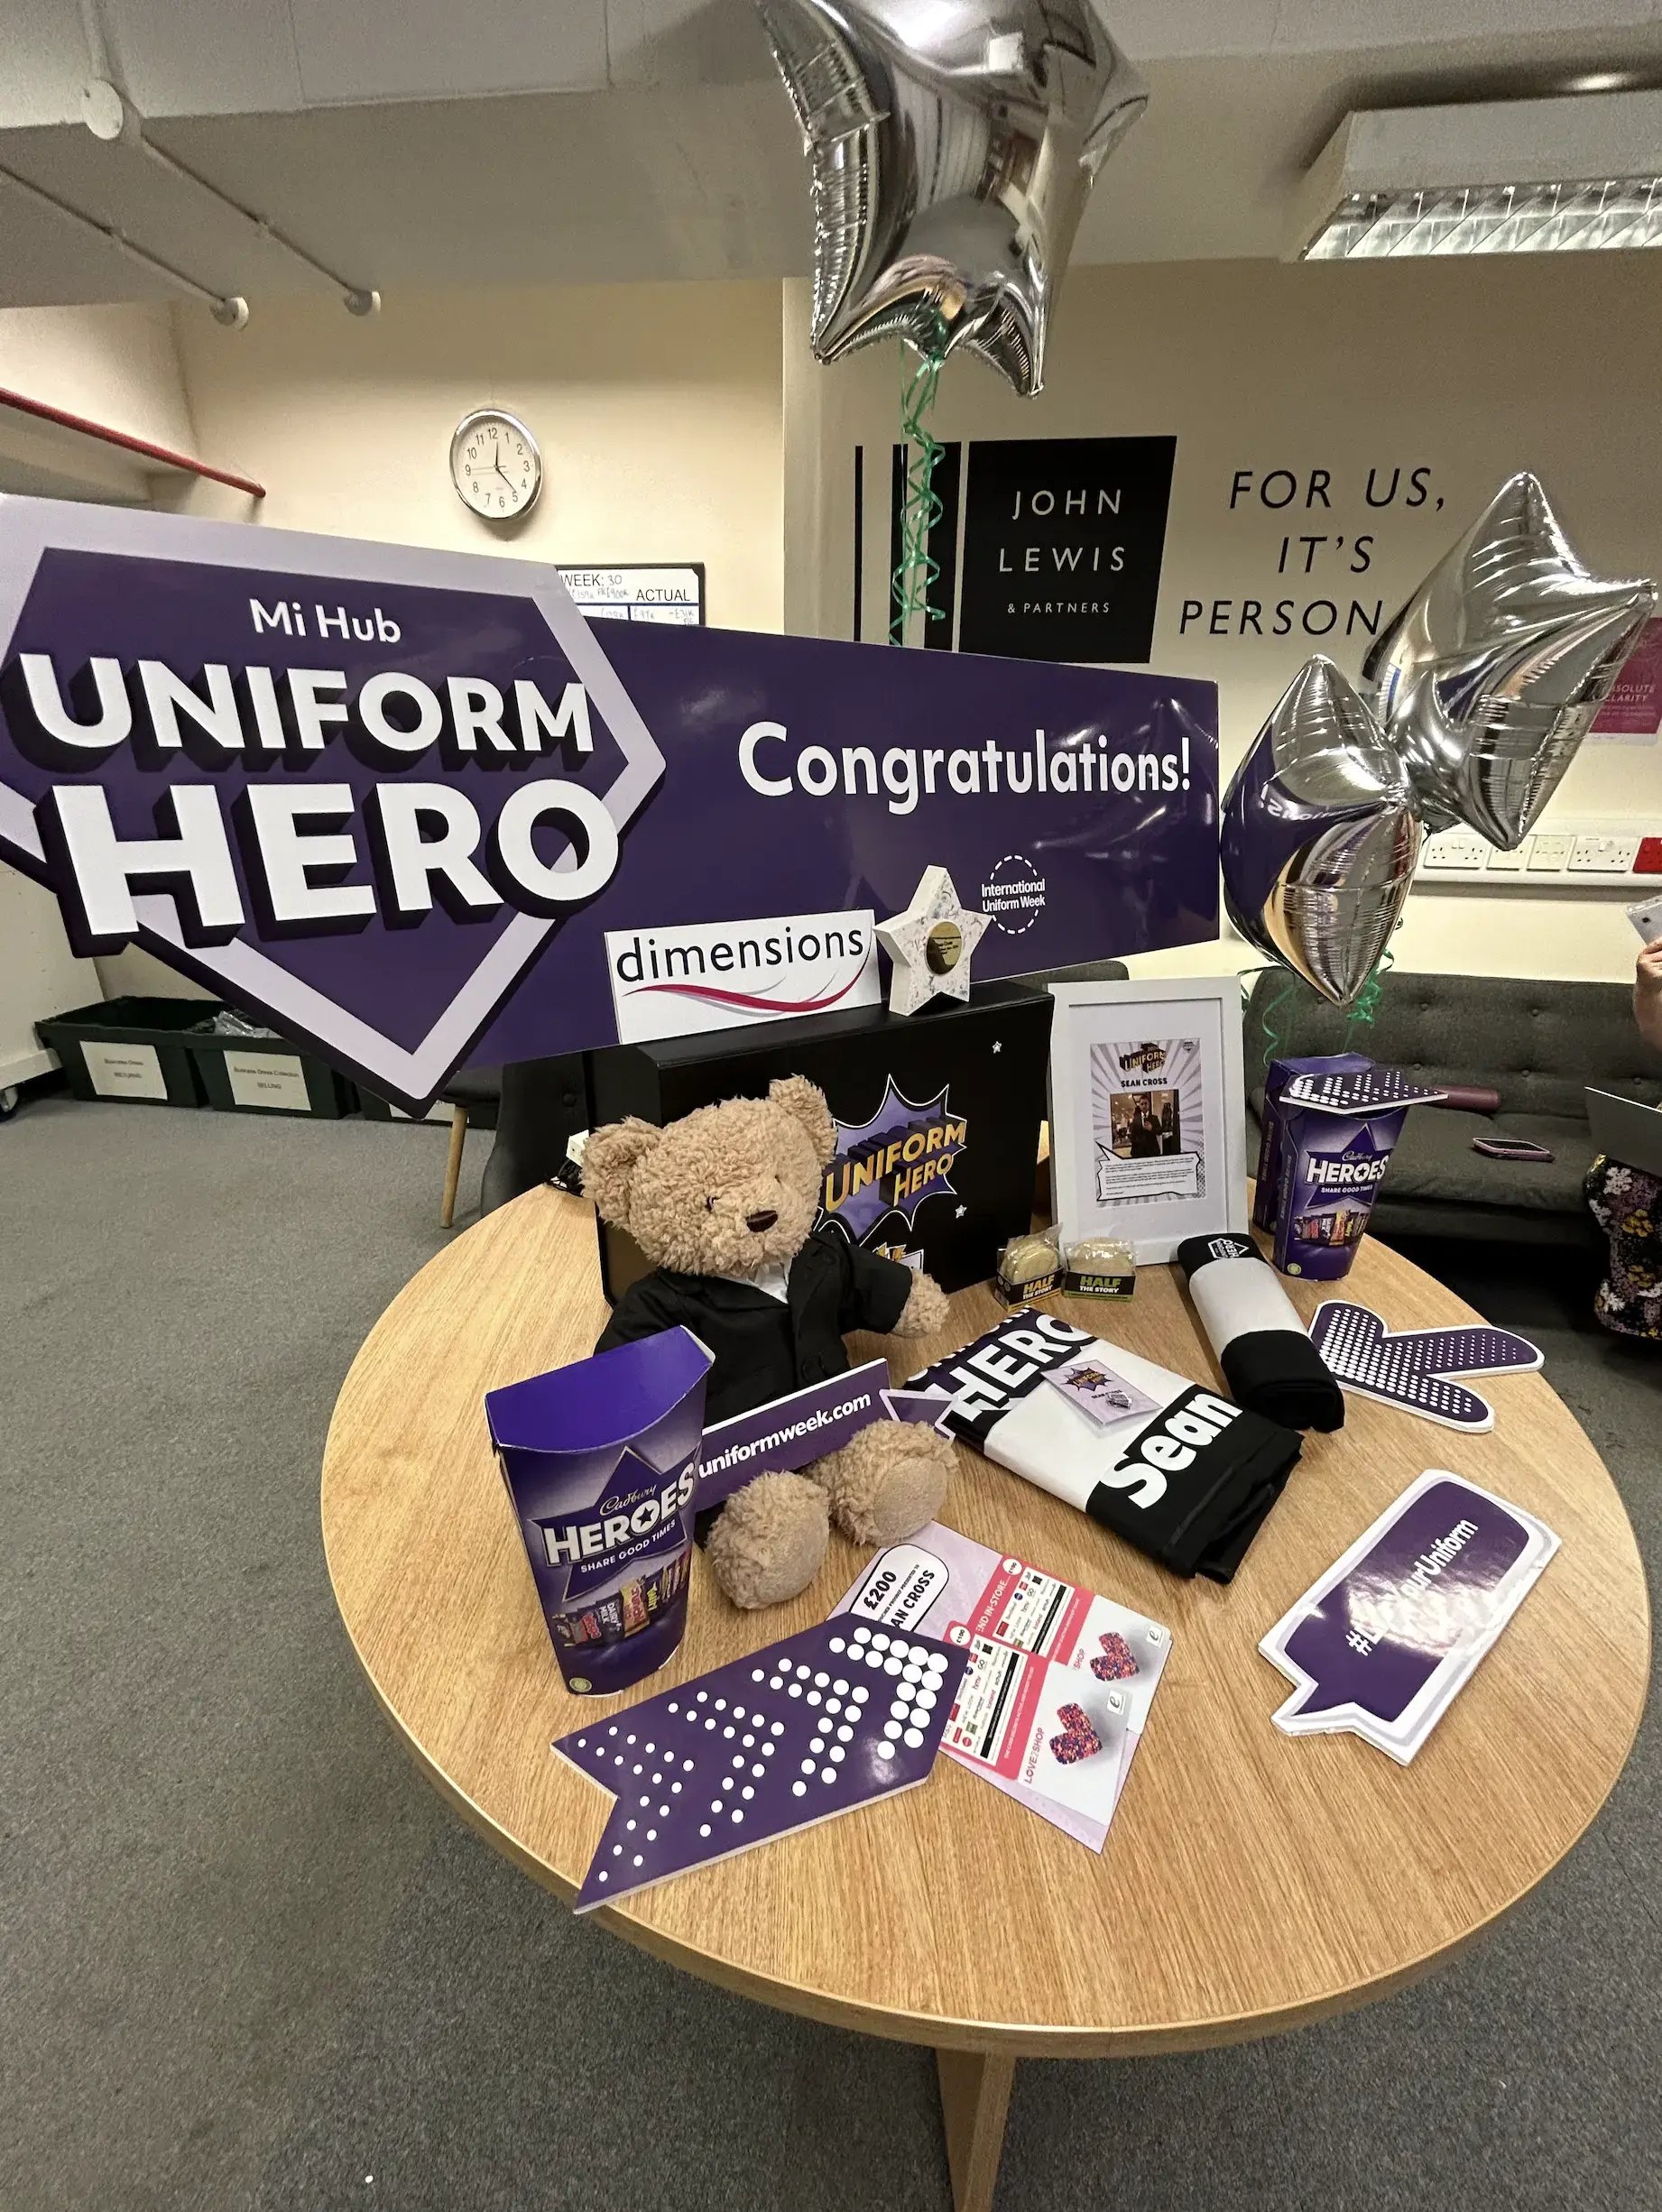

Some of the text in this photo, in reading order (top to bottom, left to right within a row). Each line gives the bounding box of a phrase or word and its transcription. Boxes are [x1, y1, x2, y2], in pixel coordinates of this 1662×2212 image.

[476, 433, 485, 446] 11
[488, 427, 498, 439] 12
[505, 432, 510, 444] 1
[466, 447, 477, 459] 10
[516, 443, 523, 455] 2
[465, 464, 471, 476] 9
[523, 460, 531, 472] 3
[472, 481, 479, 493] 8
[521, 479, 527, 489] 4
[1229, 467, 1445, 512] FOR US,
[485, 493, 491, 505] 7
[498, 496, 505, 508] 6
[512, 491, 519, 502] 5
[1012, 488, 1122, 521] JOHN
[999, 546, 1126, 574] LEWIS
[1278, 535, 1374, 574] IT'S
[560, 574, 623, 586] WEEK: 30
[636, 588, 691, 602] ACTUAL
[1007, 602, 1111, 614] & PARTNERS
[1178, 599, 1384, 636] PERSON
[249, 598, 402, 643] Mi Hub
[1615, 684, 1657, 693] SOLUTE
[19, 652, 595, 754] UNIFORM
[738, 721, 1191, 816] Congratulations!
[51, 778, 620, 935] HERO
[981, 878, 1046, 898] International
[982, 894, 1046, 913] Uniform Week
[616, 926, 863, 982] dimensions
[1121, 1077, 1168, 1088] SEAN CROSS
[825, 1120, 967, 1213] UNIFORM
[1306, 1155, 1390, 1184] HEROES
[893, 1153, 954, 1208] HERO
[1022, 1291, 1034, 1300] THE
[1034, 1285, 1053, 1297] STORY
[1023, 1276, 1056, 1295] HALF
[1079, 1275, 1122, 1288] HALF
[925, 1313, 1093, 1422] HERO
[698, 1393, 872, 1479] uniformweek.com
[1099, 1391, 1243, 1509] Sean
[599, 1484, 658, 1516] Cadbury
[543, 1462, 695, 1565] HEROES
[580, 1519, 676, 1573] SHARE GOOD TIMES
[863, 1571, 897, 1610] £200
[891, 1570, 935, 1628] AN CROSS
[1024, 1727, 1045, 1784] LOVE2SHOP
